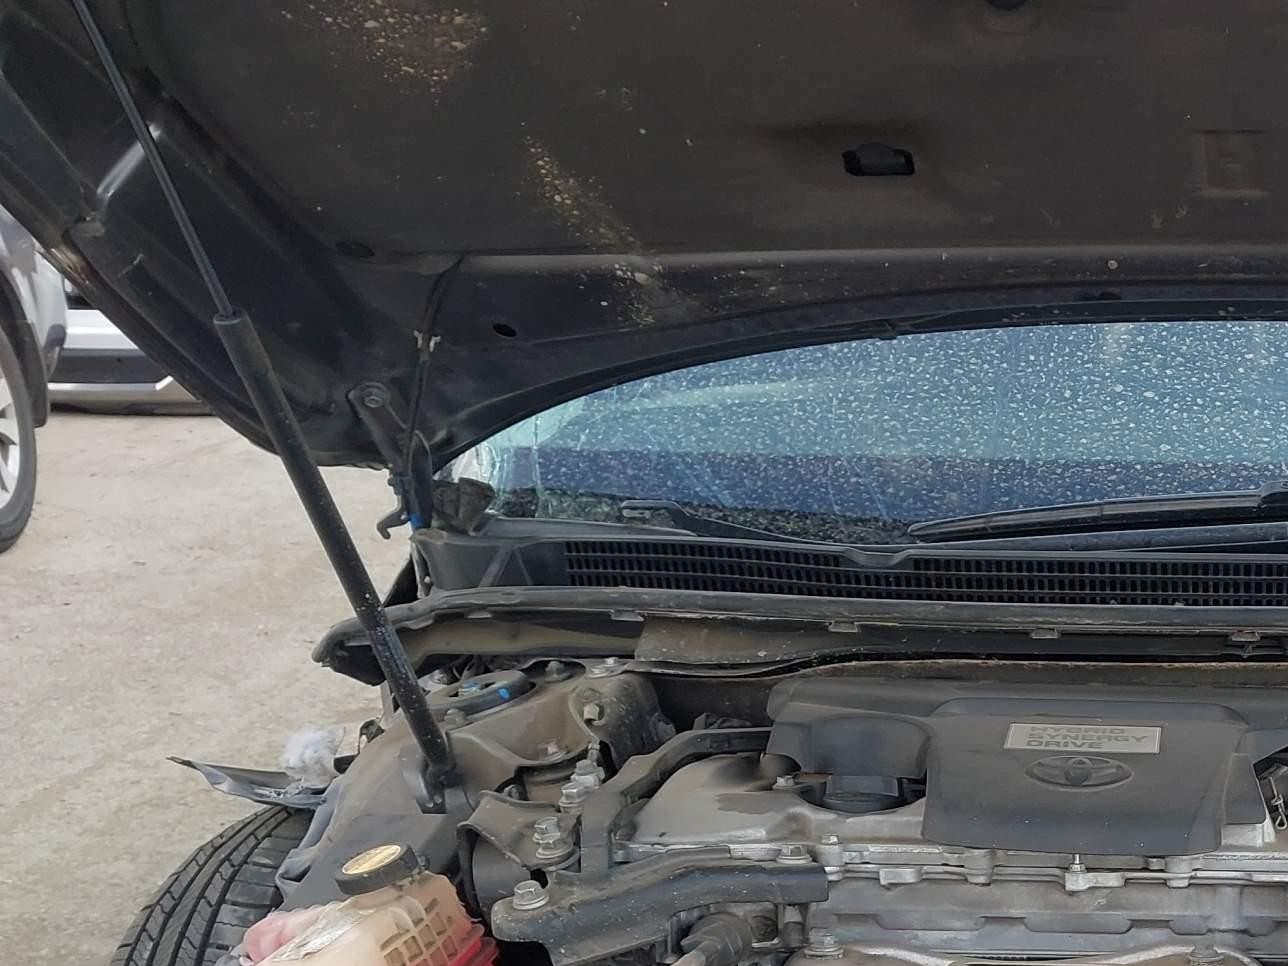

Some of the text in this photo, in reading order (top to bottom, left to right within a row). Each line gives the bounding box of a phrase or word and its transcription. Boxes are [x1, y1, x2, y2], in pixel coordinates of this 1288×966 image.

[1030, 726, 1125, 735] HYBRID
[1028, 733, 1147, 742] SYNERGY
[1026, 740, 1104, 749] DRIVE
